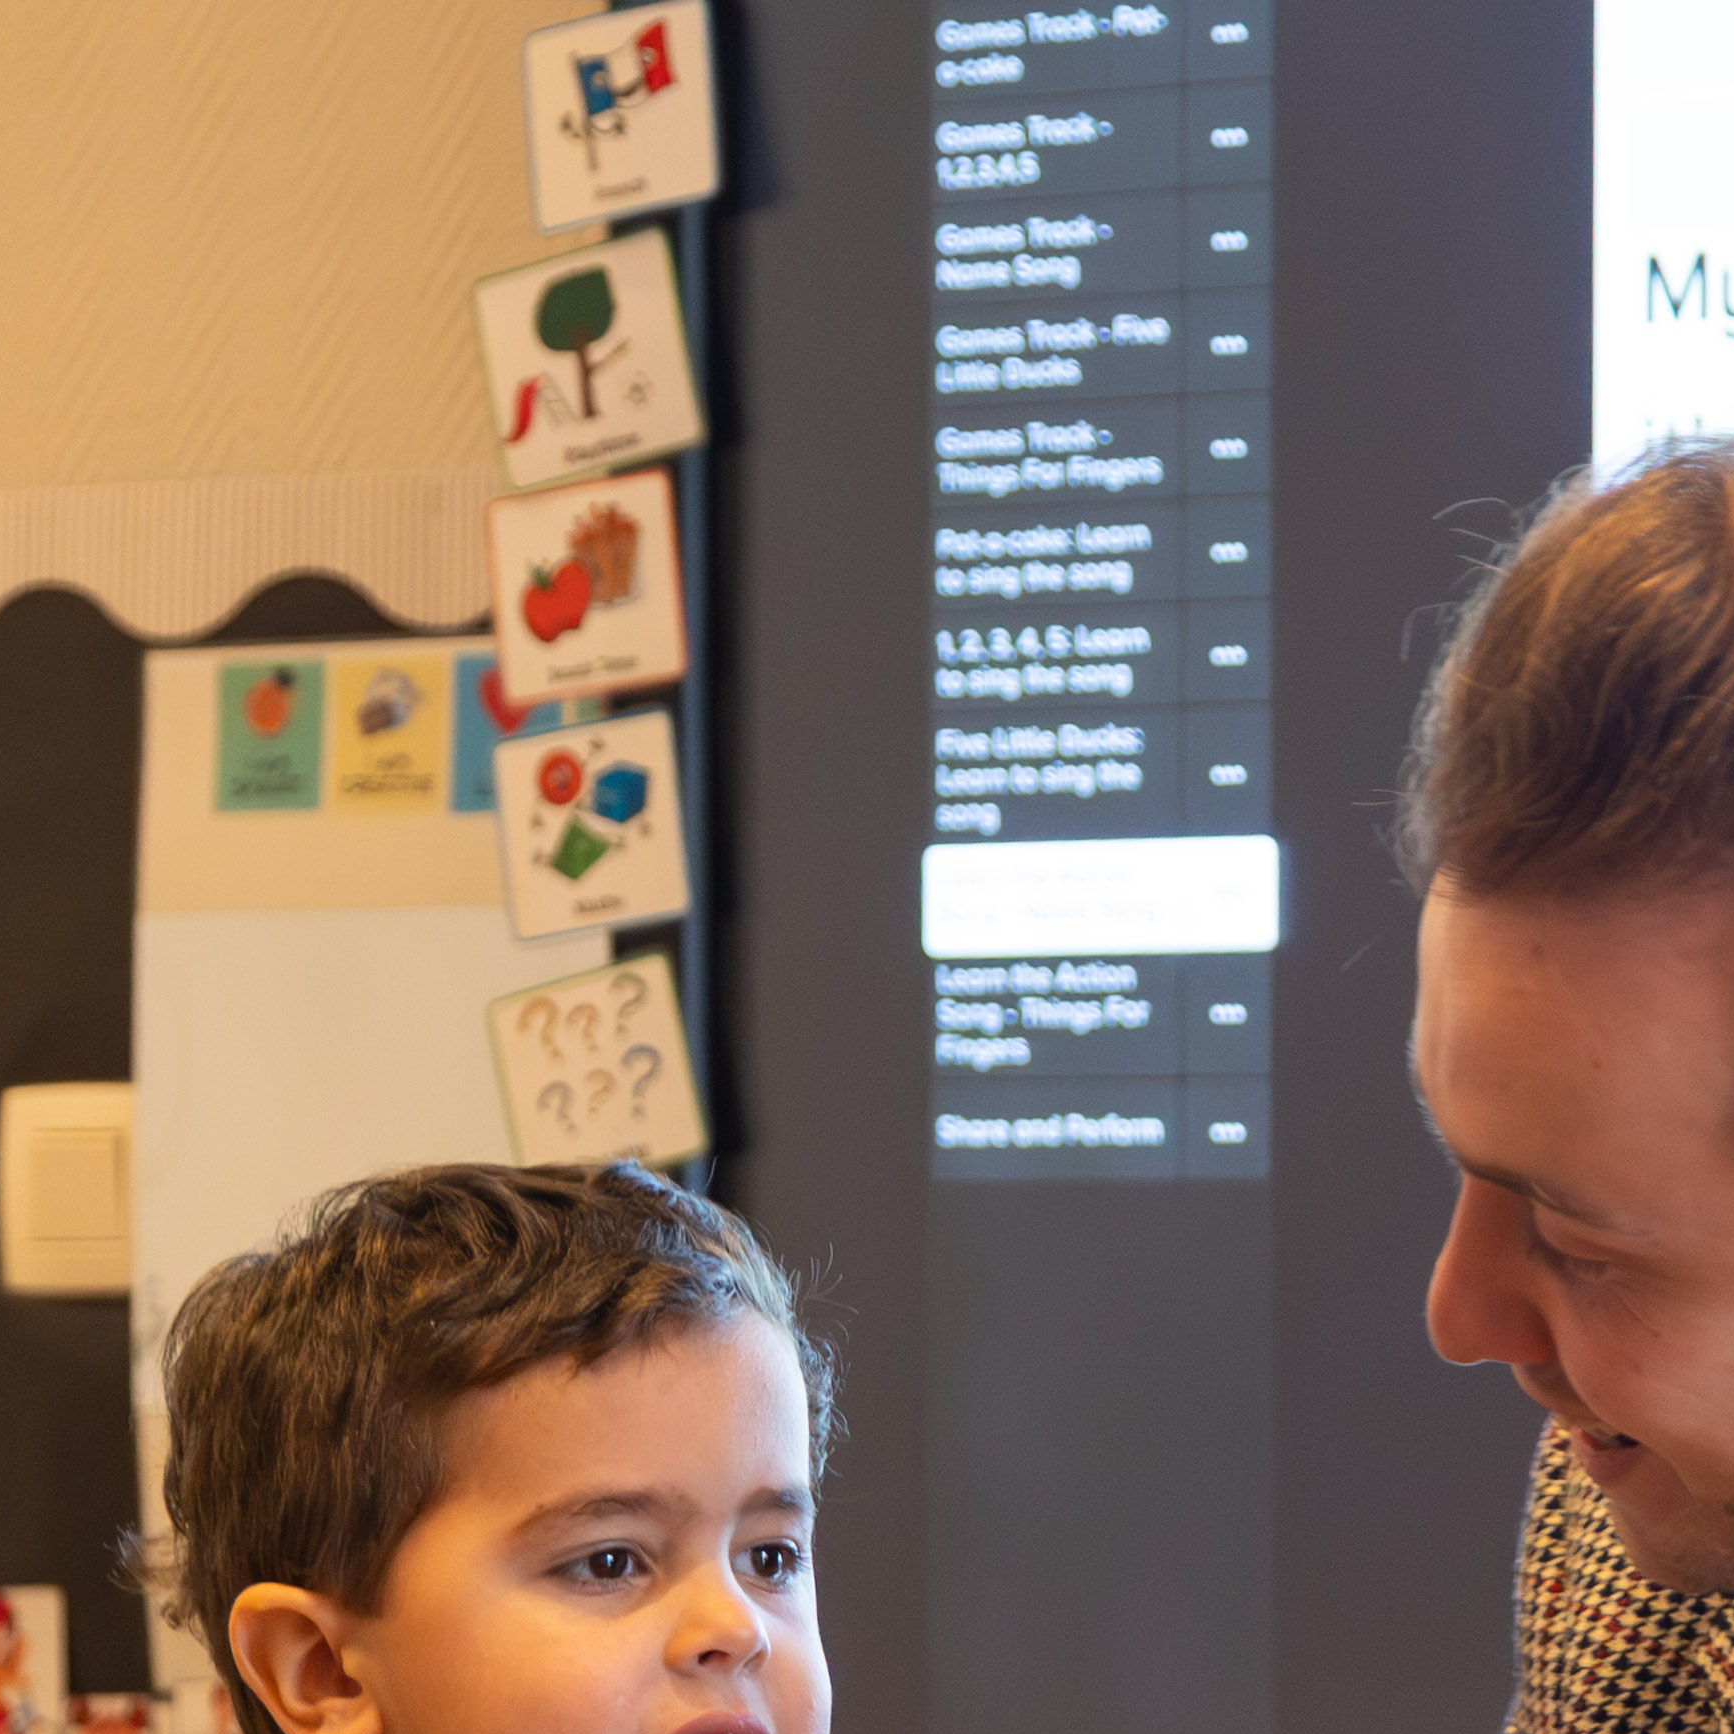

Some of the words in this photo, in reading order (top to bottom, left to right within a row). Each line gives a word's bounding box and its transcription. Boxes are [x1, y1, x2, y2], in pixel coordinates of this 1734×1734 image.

[935, 19, 1027, 52] Games
[1026, 9, 1098, 44] Track
[935, 121, 1026, 154] Games
[1026, 111, 1098, 146] Track
[935, 223, 1026, 256] Games
[1026, 214, 1098, 249] Track
[935, 259, 1012, 290] Name
[1012, 253, 1082, 290] Song
[935, 325, 1026, 358] Games
[1025, 318, 1097, 351] Track
[1111, 314, 1171, 347] Five
[935, 360, 1001, 393] Little
[1001, 355, 1083, 390] Ducks
[935, 426, 1026, 460] Games
[1025, 420, 1097, 454] Track
[936, 462, 1020, 498] Things
[1021, 456, 1065, 490] For
[1066, 455, 1164, 492] Fingers
[1075, 522, 1152, 555] Learn
[935, 565, 966, 596] to
[966, 562, 1022, 599] sing
[1022, 560, 1065, 592] the
[1065, 560, 1134, 594] song
[1074, 623, 1152, 658] Learn
[935, 667, 966, 698] to
[966, 665, 1022, 701] sing
[1022, 662, 1065, 695] the
[1065, 663, 1134, 698] song
[935, 728, 991, 761] Five
[991, 726, 1057, 760] Little
[935, 764, 1009, 798] Learn
[1009, 763, 1040, 794] to
[1040, 760, 1096, 799] sing
[1096, 759, 1143, 792] the
[935, 803, 1001, 836] song
[935, 963, 1009, 996] Learn
[1009, 961, 1055, 995] the
[1055, 960, 1138, 993] Action
[935, 997, 1004, 1036] Song
[1019, 996, 1103, 1036] Things
[1103, 994, 1152, 1029] For
[935, 1033, 1031, 1072] Fingers
[935, 1113, 1011, 1149] Share
[1011, 1114, 1063, 1148] and
[1063, 1112, 1165, 1148] Perform
